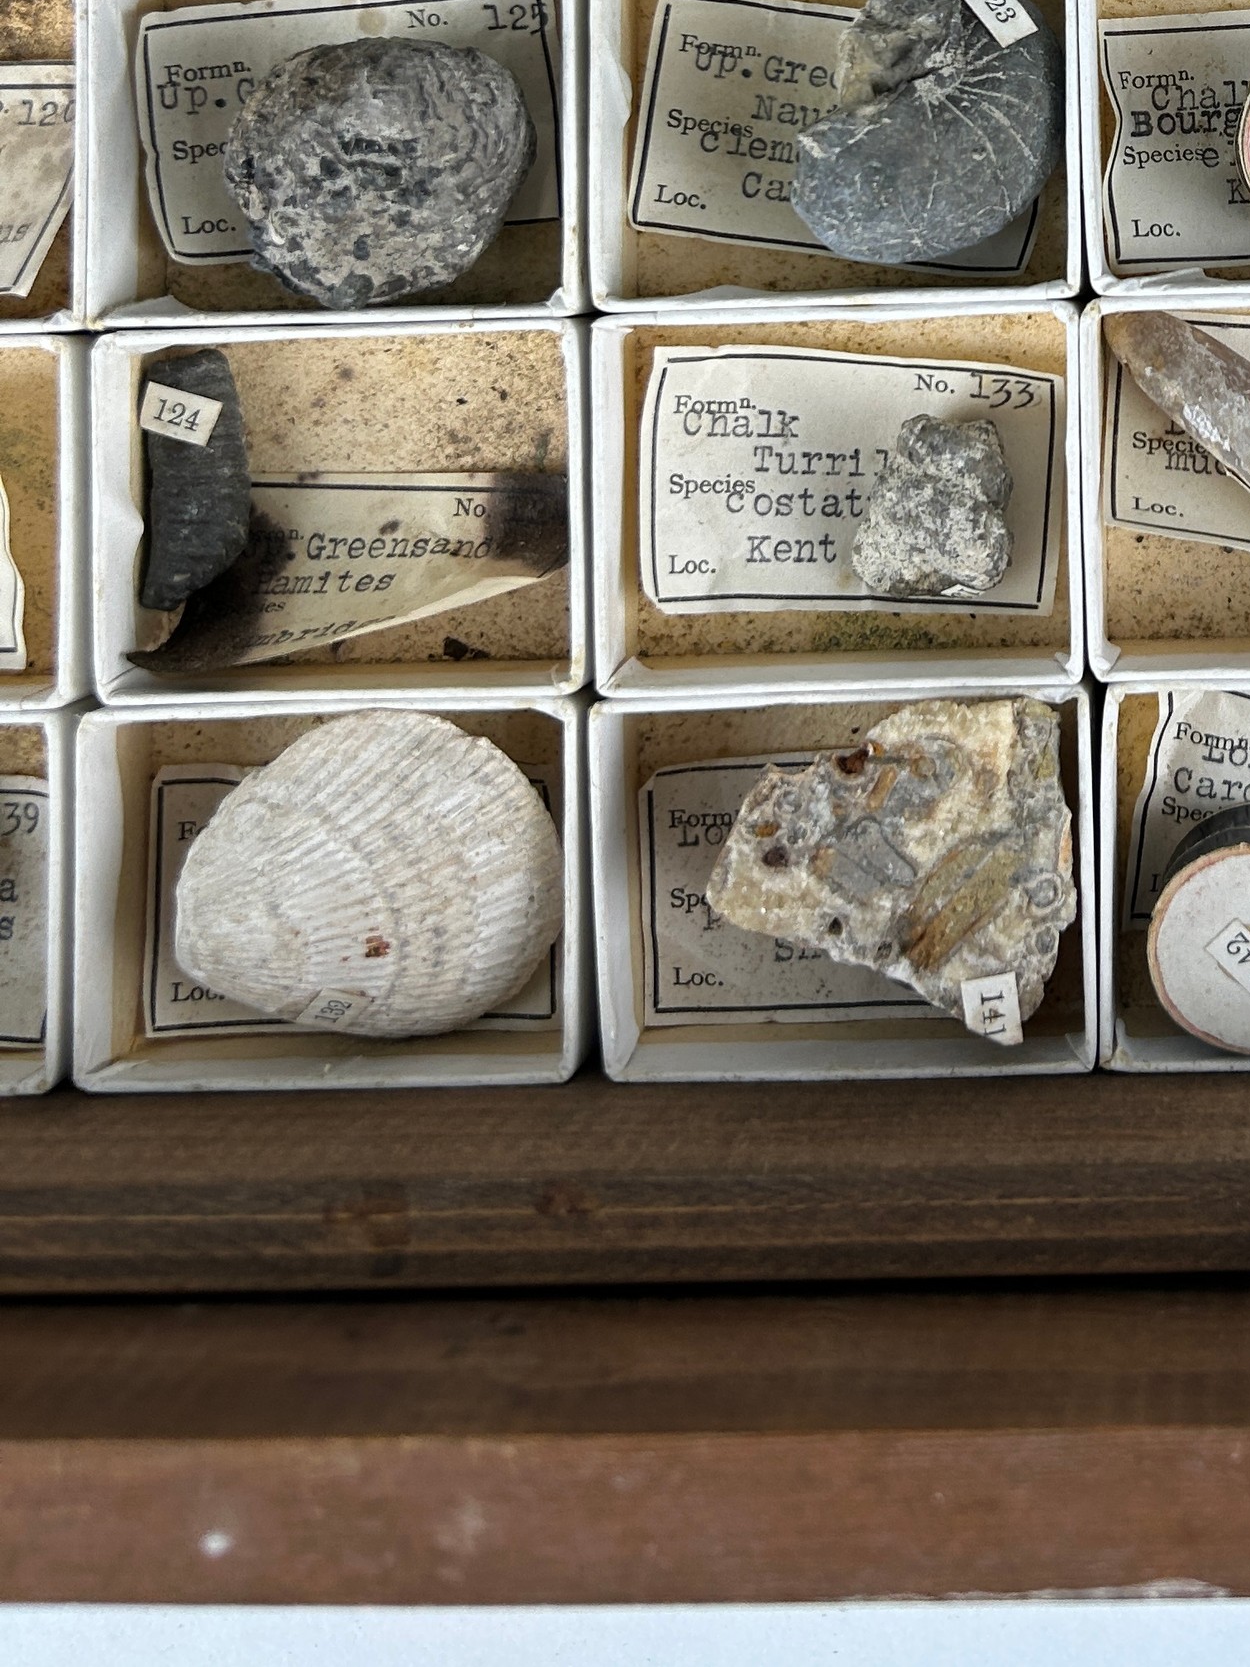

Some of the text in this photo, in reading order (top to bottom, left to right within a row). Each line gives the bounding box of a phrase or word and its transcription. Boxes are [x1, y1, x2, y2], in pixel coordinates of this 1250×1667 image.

[407, 9, 449, 29] No.
[666, 109, 754, 138] Species
[655, 185, 707, 210] Loc.
[182, 215, 236, 235] Loc.
[1132, 219, 1181, 238] Loc.
[914, 372, 1036, 409] No. 133
[153, 398, 200, 431] 124
[684, 410, 799, 439] Chalk
[669, 475, 755, 498] Species
[1132, 497, 1184, 518] Loc.
[746, 533, 837, 565] Kent
[669, 555, 716, 575] Loc.
[673, 967, 724, 987] Loc.
[313, 997, 353, 1024] 132
